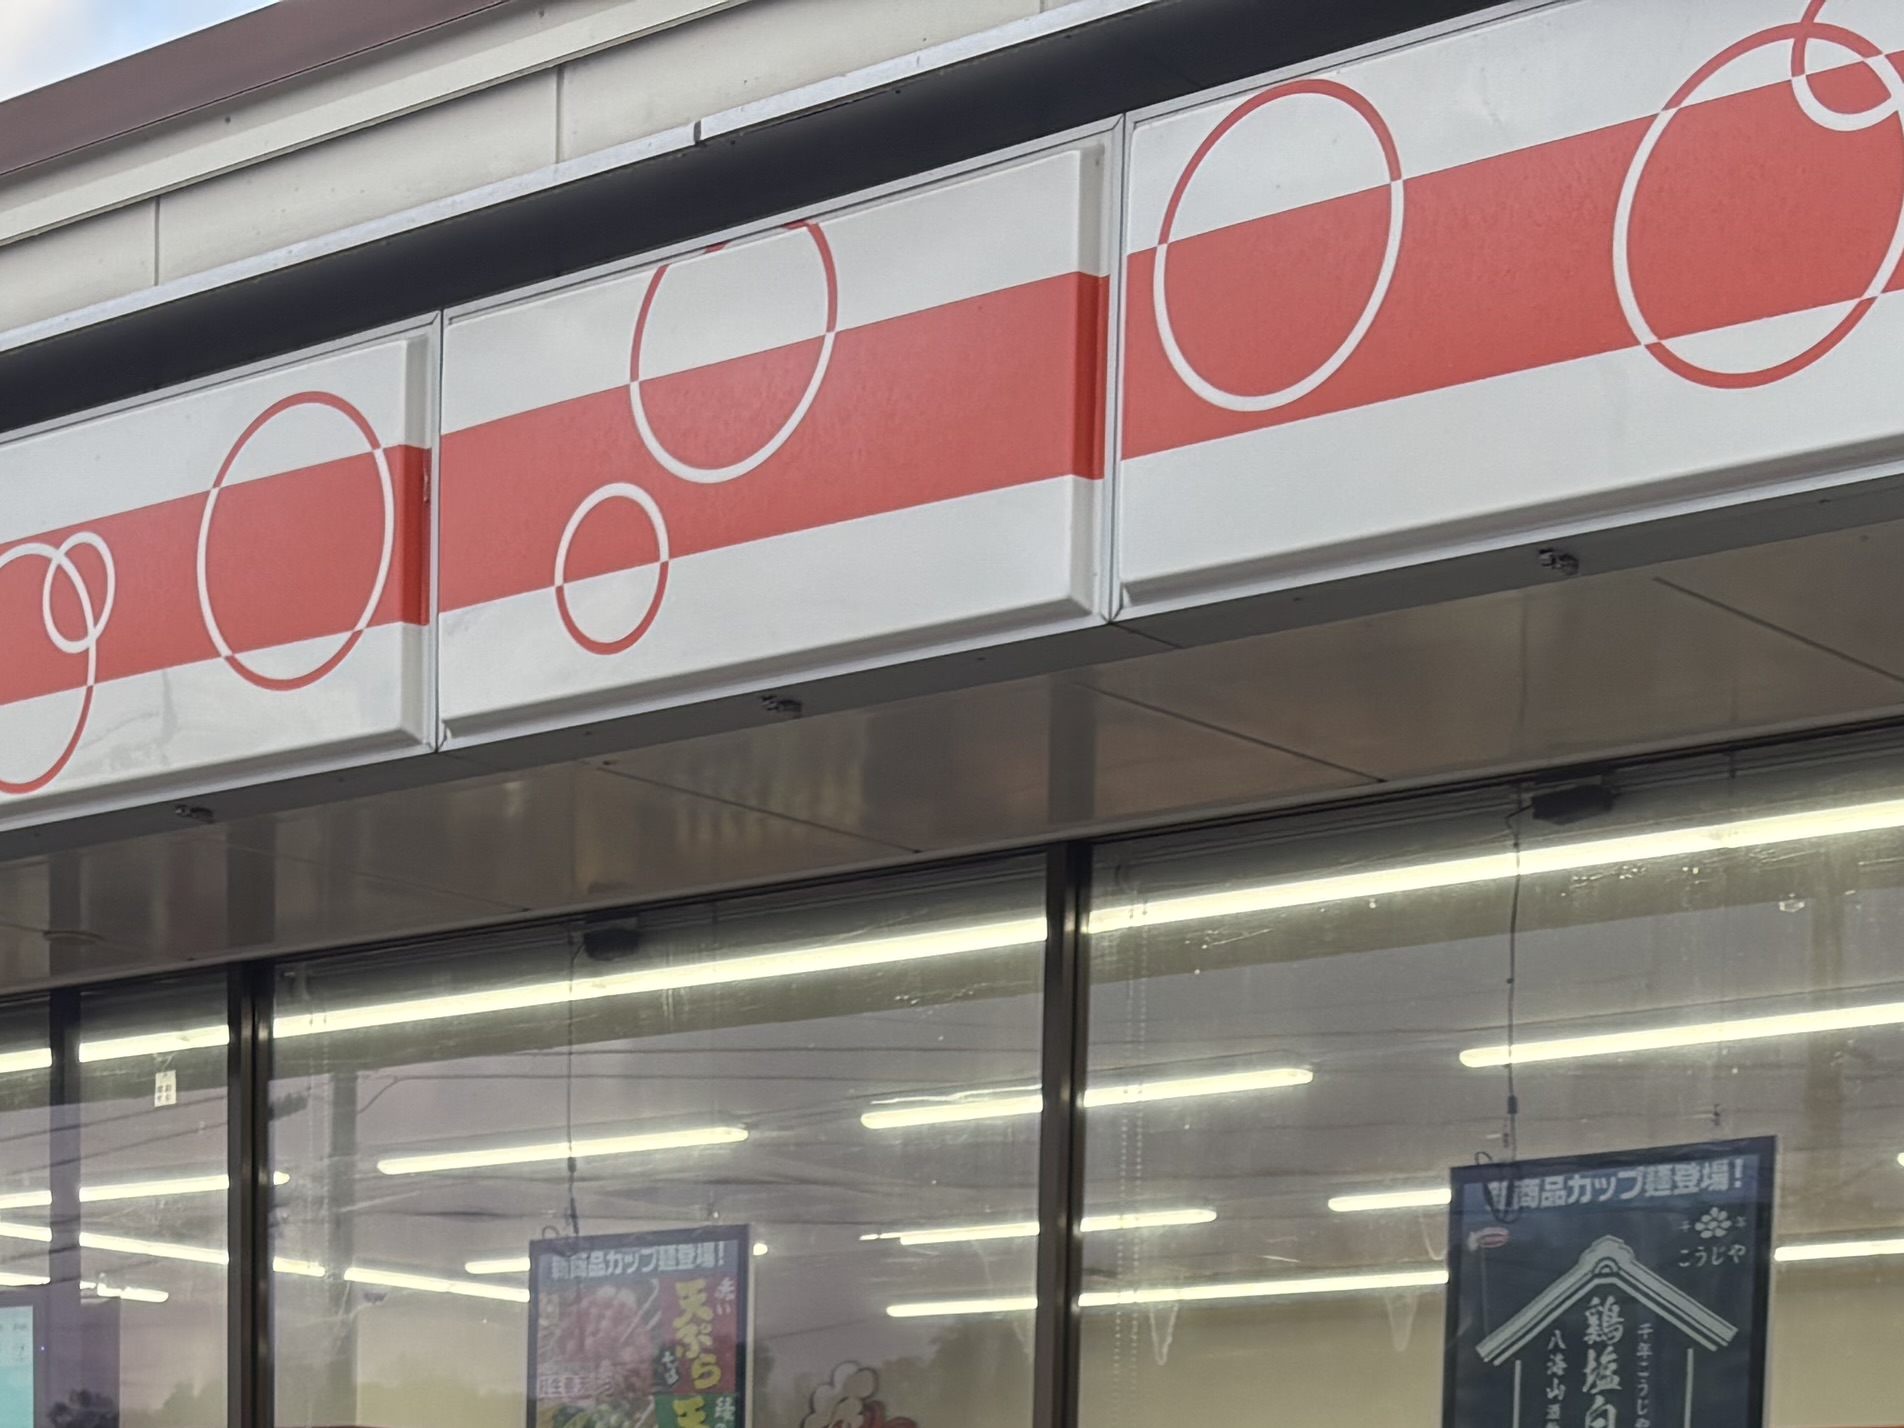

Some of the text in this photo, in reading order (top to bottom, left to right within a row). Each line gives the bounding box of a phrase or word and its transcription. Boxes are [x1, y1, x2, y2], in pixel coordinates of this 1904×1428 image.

[1677, 1245, 1747, 1268] こうじや
[673, 1278, 723, 1391] 天ぷら
